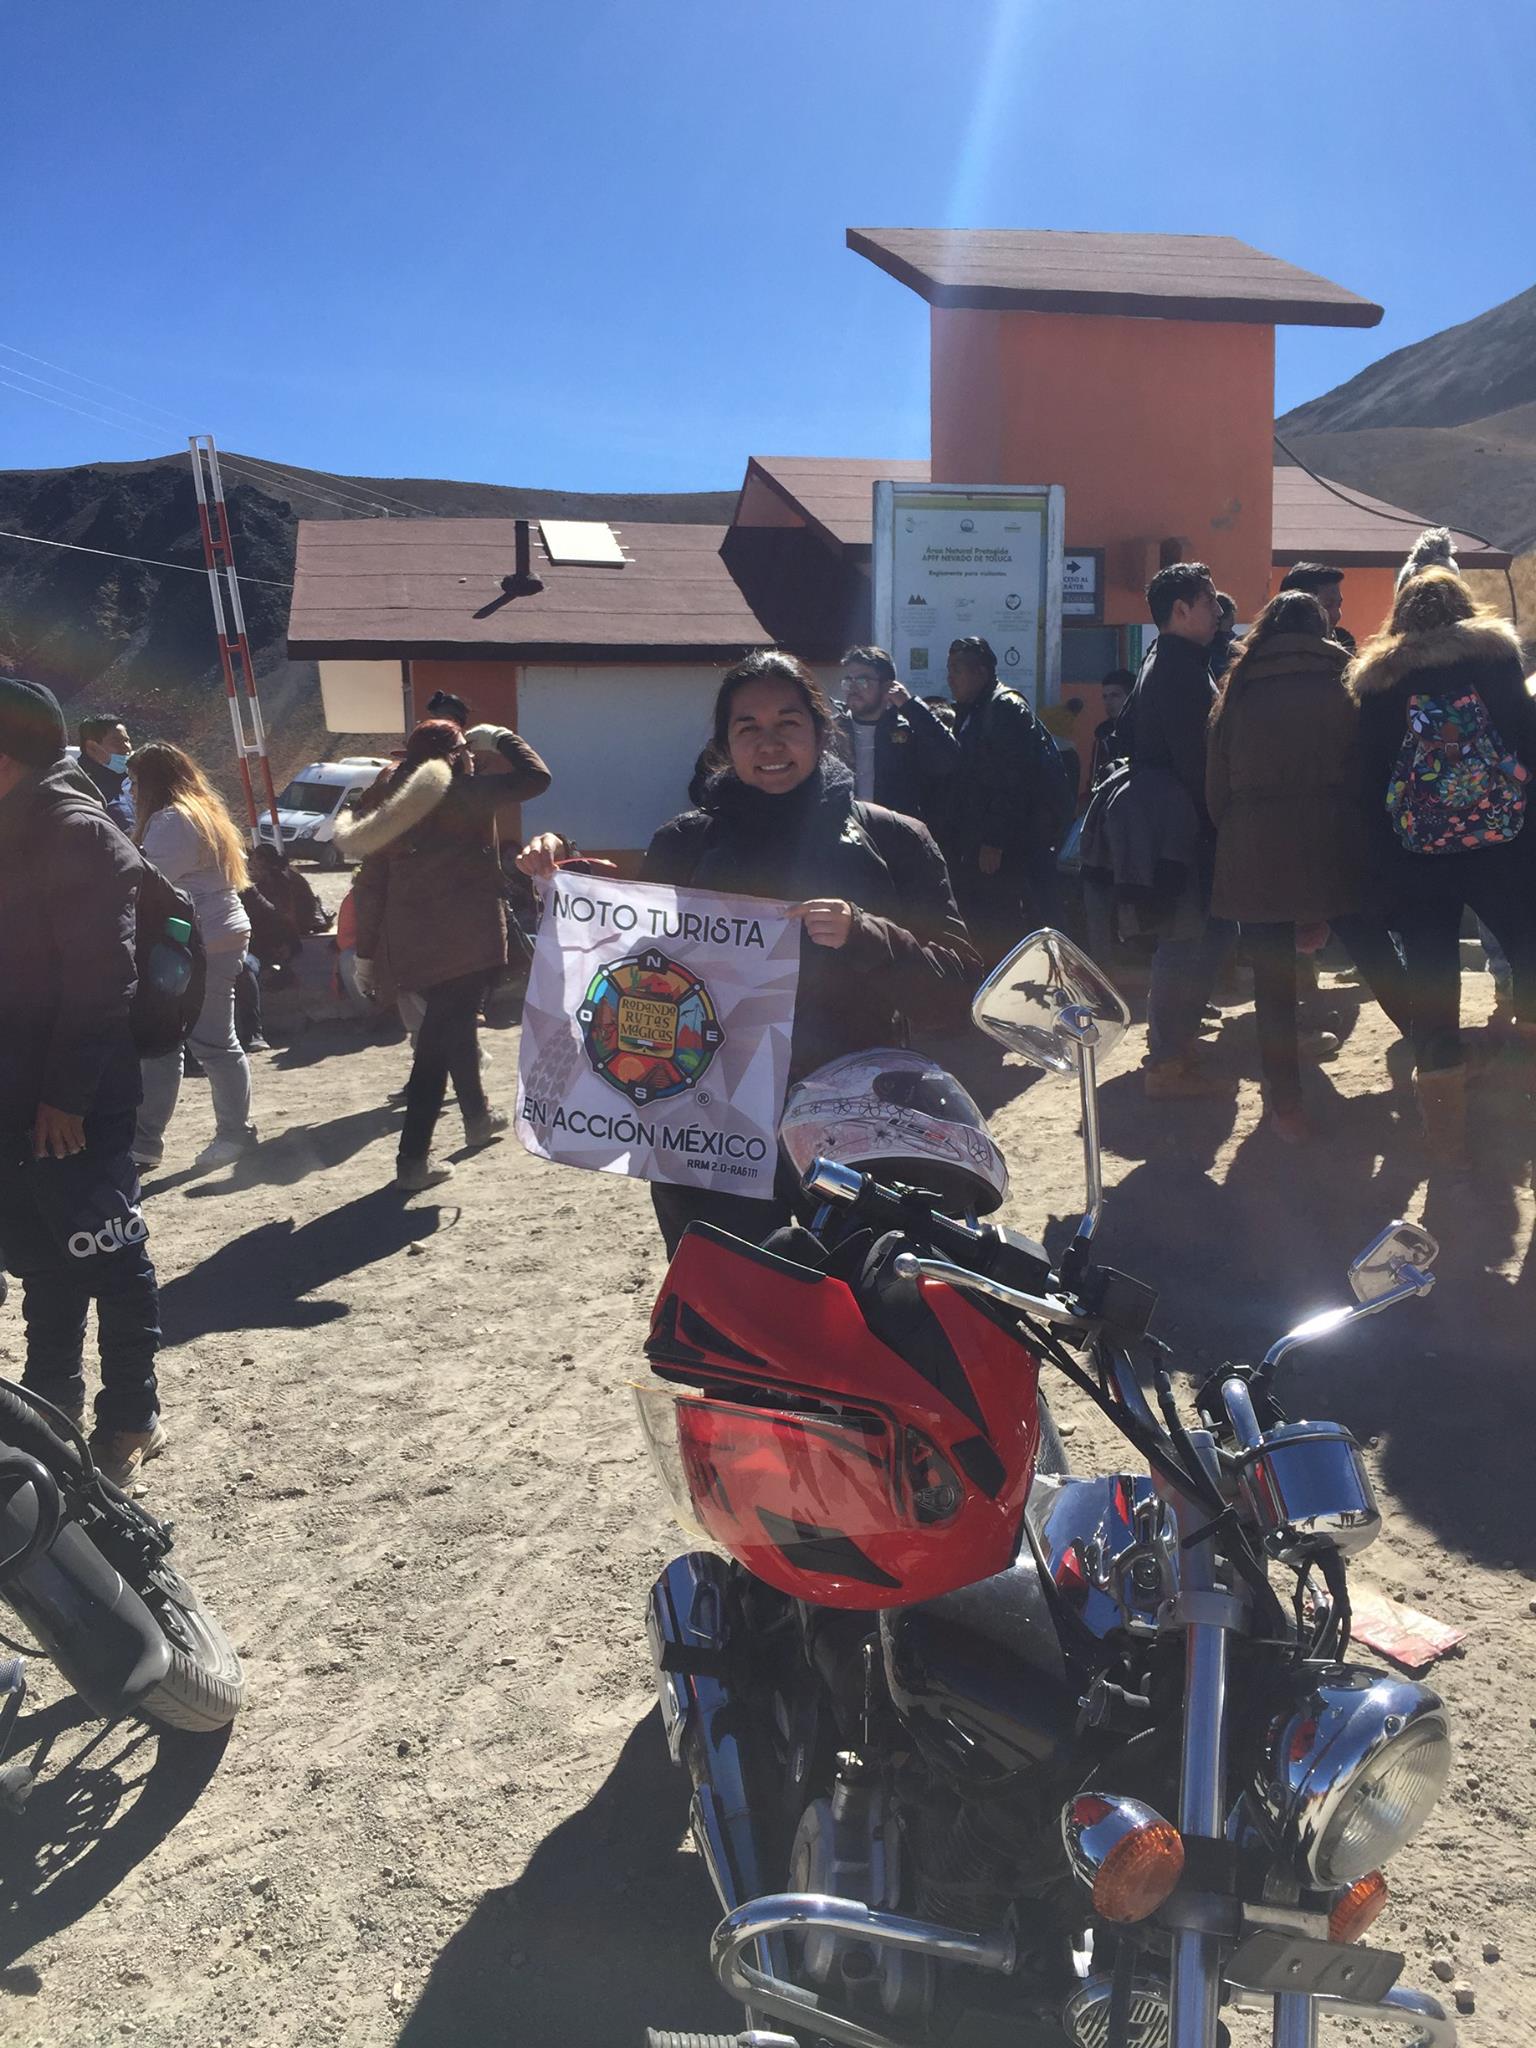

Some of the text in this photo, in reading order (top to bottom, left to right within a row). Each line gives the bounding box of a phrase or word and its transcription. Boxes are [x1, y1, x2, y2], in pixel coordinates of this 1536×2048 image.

[945, 546, 973, 554] Natural
[552, 890, 765, 949] MOTO TURISTA
[646, 956, 661, 969] N
[580, 1009, 593, 1022] O
[706, 1030, 718, 1042] E
[634, 1087, 647, 1099] S
[522, 1096, 767, 1162] EN ACCIÓN MÉXICO
[687, 1159, 710, 1170] RRM
